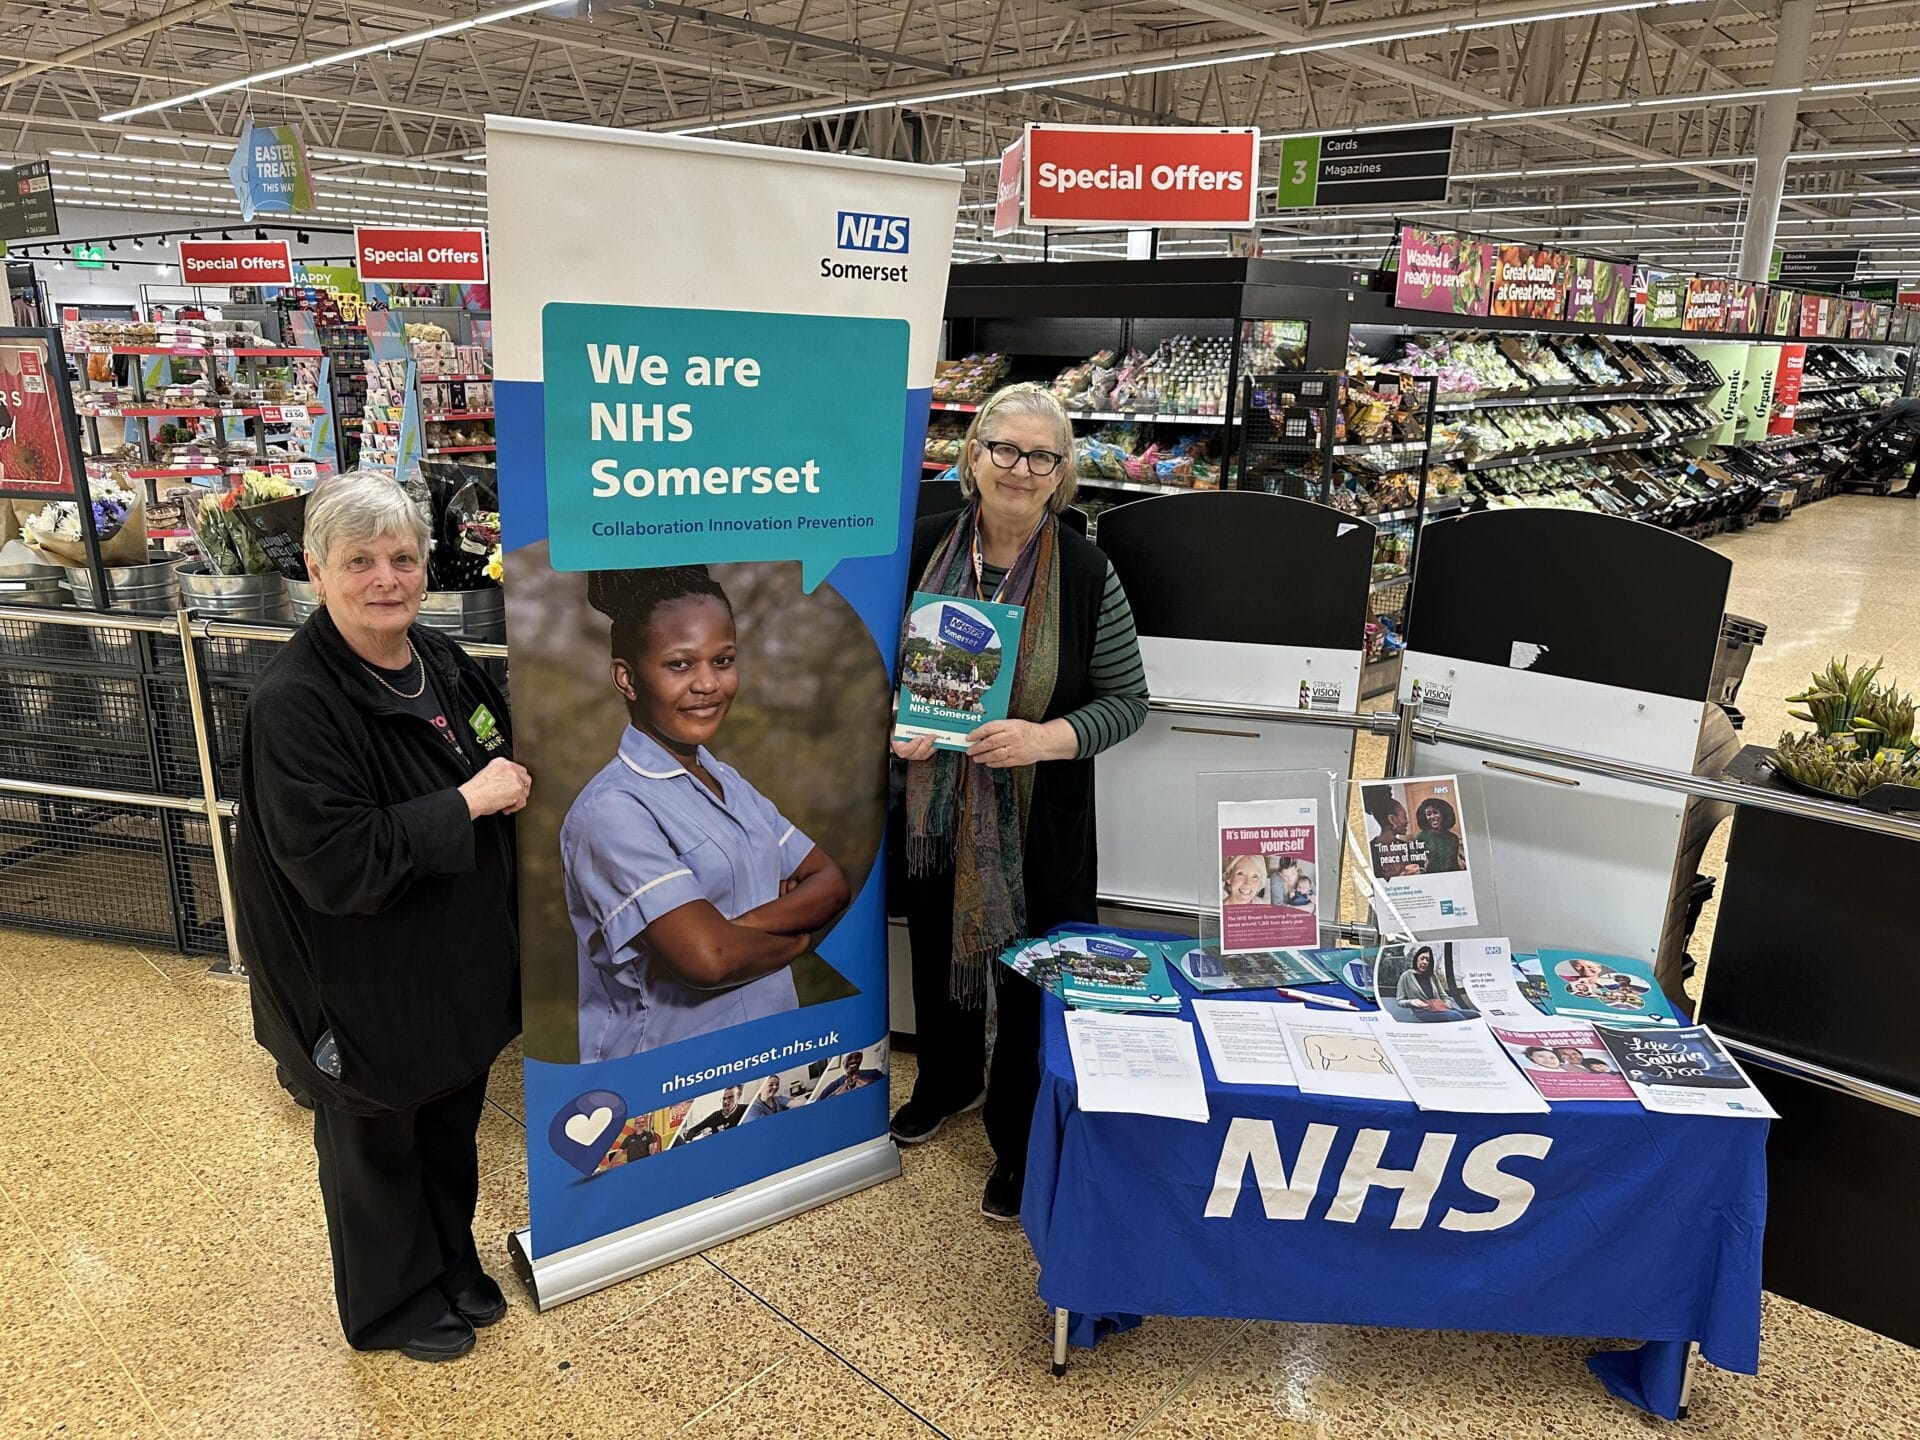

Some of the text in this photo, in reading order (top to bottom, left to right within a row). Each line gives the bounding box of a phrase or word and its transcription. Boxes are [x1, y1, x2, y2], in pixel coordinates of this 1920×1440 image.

[255, 144, 295, 161] EASTER
[1327, 139, 1358, 151] Cards
[256, 162, 297, 178] TREATS
[1038, 162, 1243, 193] Special Offers
[1291, 160, 1308, 185] 3
[1325, 163, 1381, 176] Magazines
[262, 183, 295, 192] THIS WAY
[840, 214, 908, 250] NHS
[186, 256, 286, 272] Special Offers
[364, 247, 479, 265] Special Offers
[1406, 249, 1449, 268] Washed &
[820, 258, 908, 282] Somerset
[1404, 268, 1465, 288] ready to serve
[1502, 262, 1556, 285] Great Quality
[294, 273, 332, 284] HAPPY
[1576, 276, 1592, 292] Crisp
[1498, 284, 1556, 300] at Great Prices
[1580, 292, 1594, 305] mild
[1690, 290, 1704, 304] Great
[586, 343, 761, 387] We are
[1720, 369, 1740, 420] Organic
[1754, 369, 1773, 418] Organic
[590, 402, 693, 442] NHS
[590, 458, 820, 498] Somerset
[592, 514, 874, 537] Collaboration Innovation Prevention
[944, 626, 978, 647] Somerset
[1312, 681, 1342, 690] STRONG
[1312, 688, 1340, 697] VISION
[1424, 682, 1453, 693] STRONG
[910, 693, 946, 706] We are
[1424, 689, 1452, 701] VISION
[909, 704, 930, 714] NHS
[932, 707, 982, 722] Somerset
[1433, 786, 1448, 794] NHS
[1226, 828, 1310, 840] It's time to look after
[1260, 838, 1305, 853] yourself
[1390, 841, 1408, 852] doing
[1409, 841, 1414, 849] it
[1415, 840, 1426, 849] for
[1380, 856, 1400, 866] peace
[1401, 854, 1409, 862] of
[1540, 1037, 1594, 1046] yourself
[1624, 1037, 1687, 1055] Life
[661, 1030, 840, 1094] nhssomerset.nhs.uk
[1626, 1052, 1710, 1070] Saving
[1658, 1064, 1704, 1080] Poo
[1204, 1116, 1554, 1232] NHS
